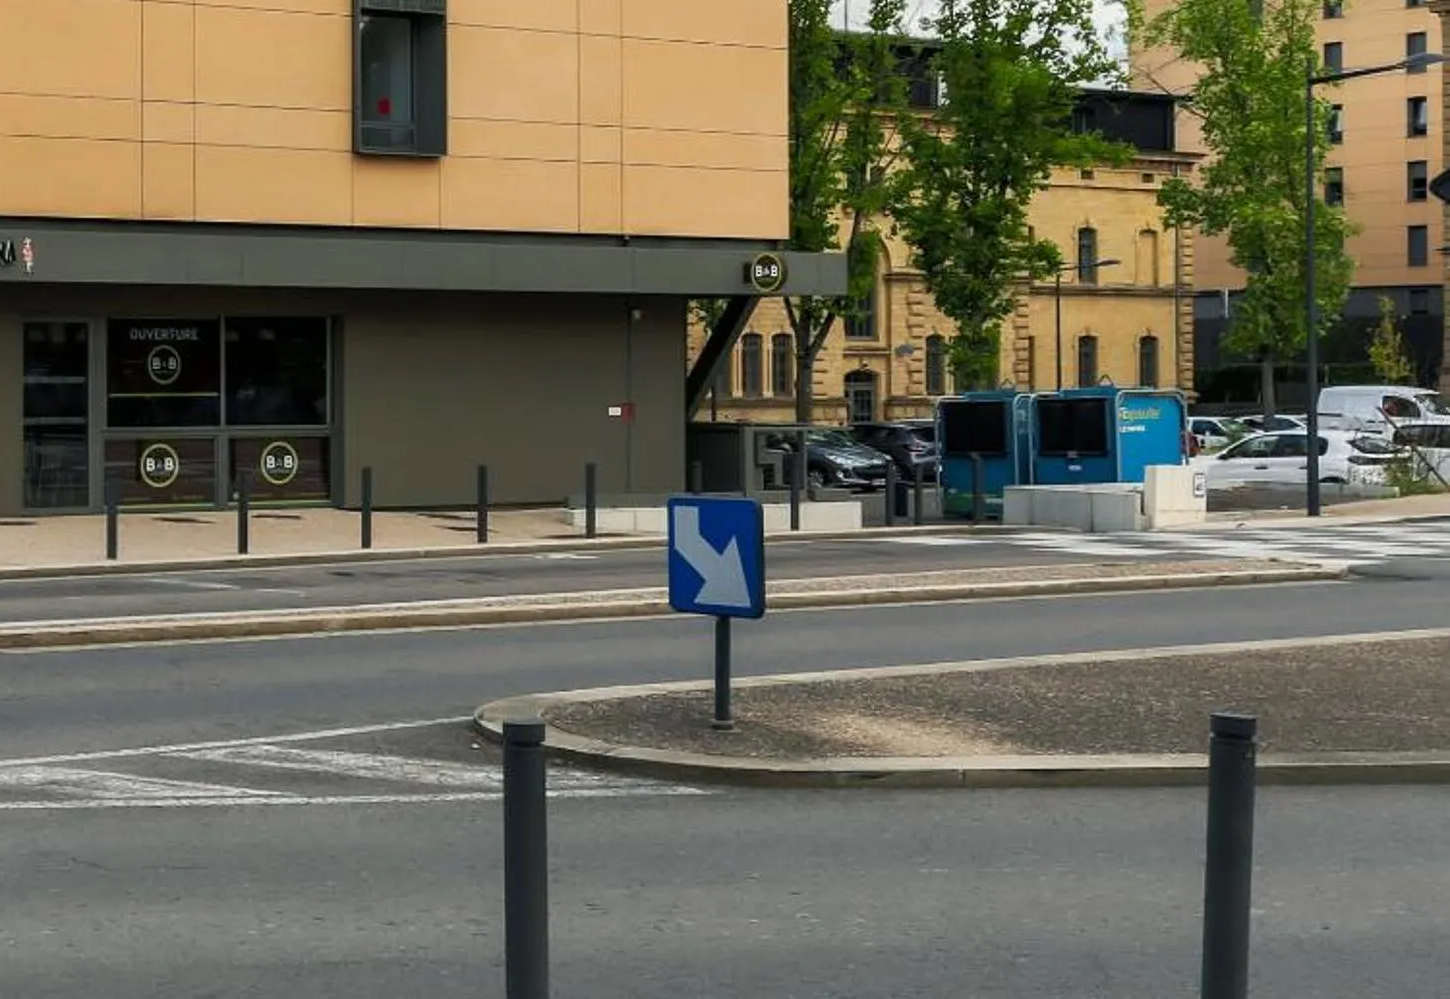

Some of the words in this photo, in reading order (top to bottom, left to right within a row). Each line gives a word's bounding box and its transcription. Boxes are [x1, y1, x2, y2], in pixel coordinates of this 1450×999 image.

[755, 264, 778, 277] B&B
[130, 327, 199, 341] OUVERTURE
[146, 457, 175, 472] B&B
[266, 455, 293, 468] B&B
